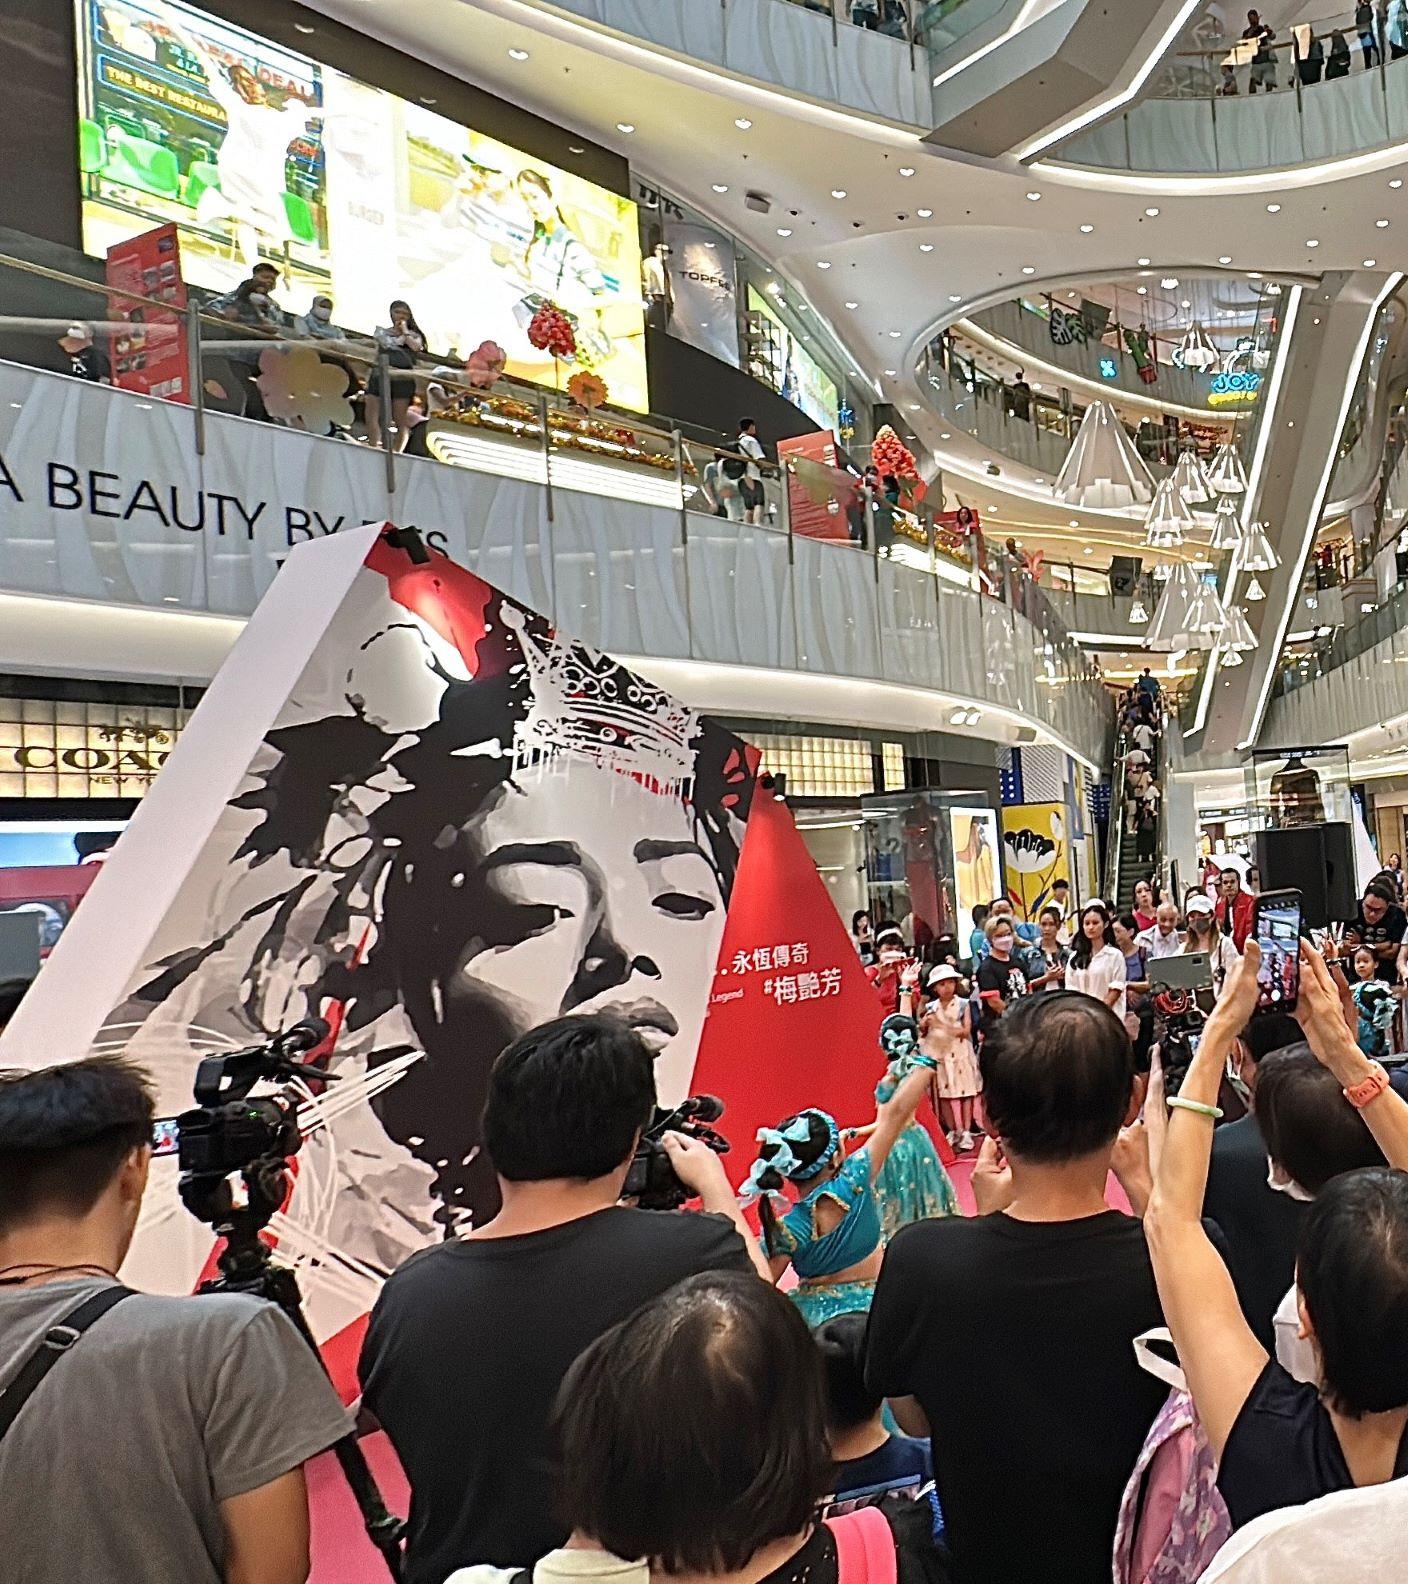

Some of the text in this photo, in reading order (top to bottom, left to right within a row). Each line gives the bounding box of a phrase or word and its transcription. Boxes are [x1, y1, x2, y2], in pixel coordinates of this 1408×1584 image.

[136, 74, 165, 97] BEST
[1212, 373, 1260, 393] JOY
[47, 462, 267, 540] BEAUTY
[285, 506, 345, 546] BY
[14, 746, 170, 770] COA
[90, 776, 128, 785] NEW
[712, 988, 744, 1003] Legend
